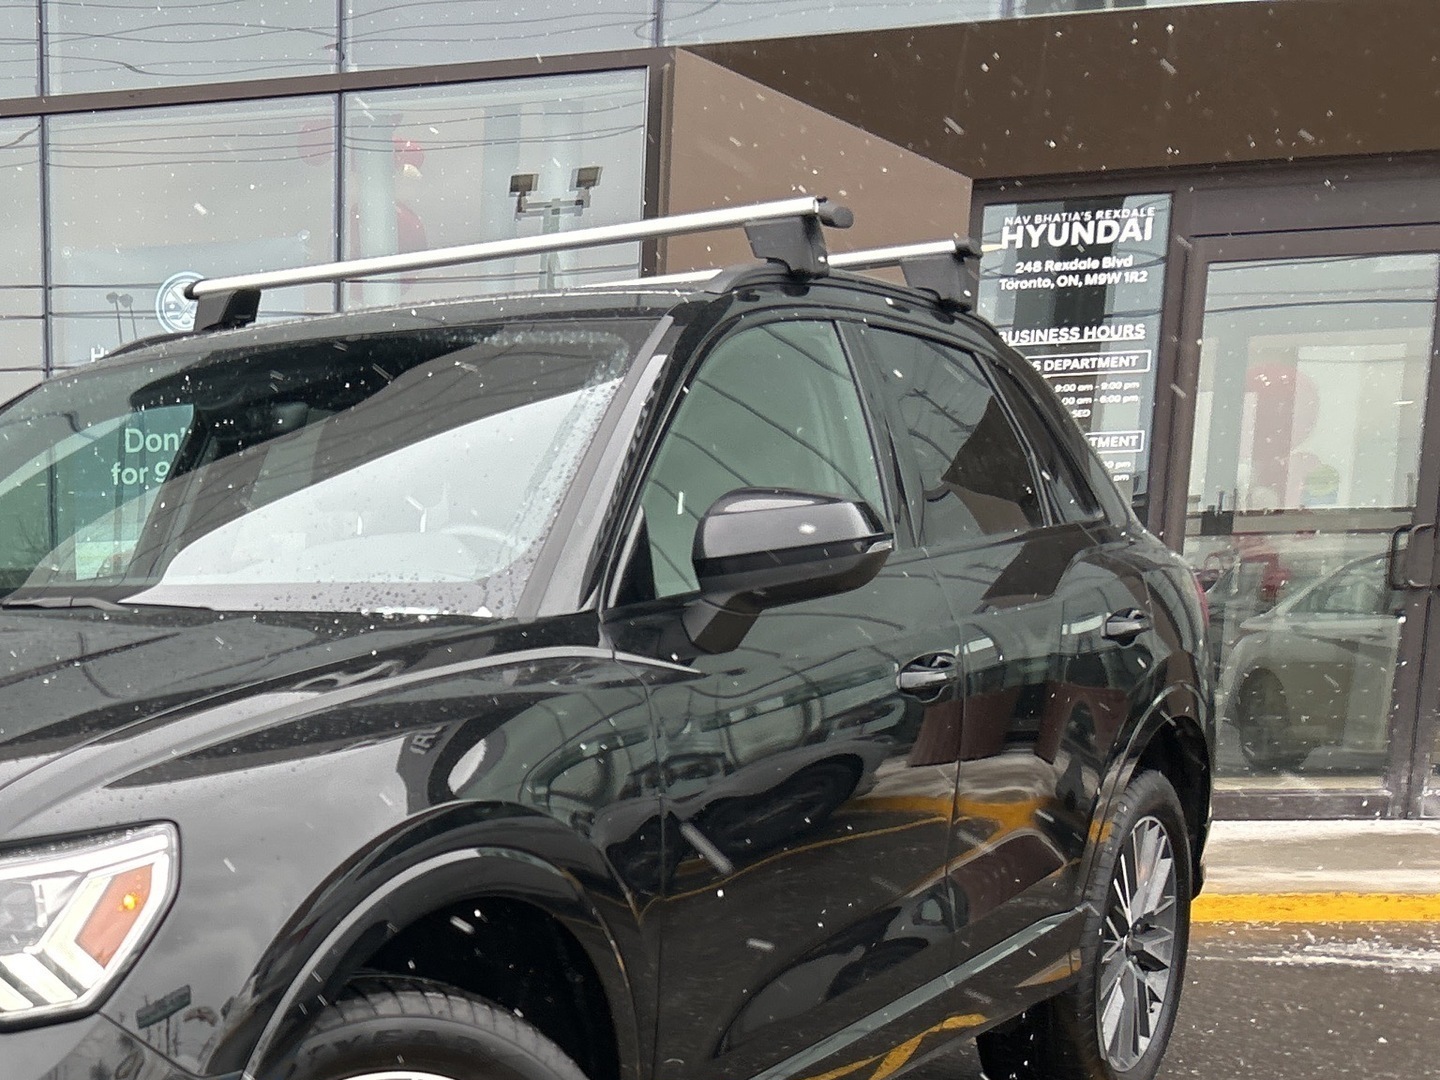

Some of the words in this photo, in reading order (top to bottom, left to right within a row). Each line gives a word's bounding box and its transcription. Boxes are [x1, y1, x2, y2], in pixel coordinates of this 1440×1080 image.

[1004, 216, 1032, 226] NAV
[1034, 211, 1092, 224] BHATIA'S
[1095, 206, 1156, 220] REXDALE
[1001, 217, 1154, 250] HYUNDAI
[1015, 261, 1042, 274] 248
[1044, 258, 1100, 272] Rexdale
[1102, 255, 1134, 268] Blvd
[999, 277, 1055, 291] Toronto,
[1056, 274, 1083, 288] ON,
[1123, 270, 1149, 283] 1R2
[1084, 323, 1146, 340] HOURS
[1044, 355, 1139, 371] DEPARTMENT
[1070, 409, 1091, 418] SED
[124, 426, 186, 453] Don'
[1088, 435, 1138, 448] TMENT
[111, 461, 149, 486] for
